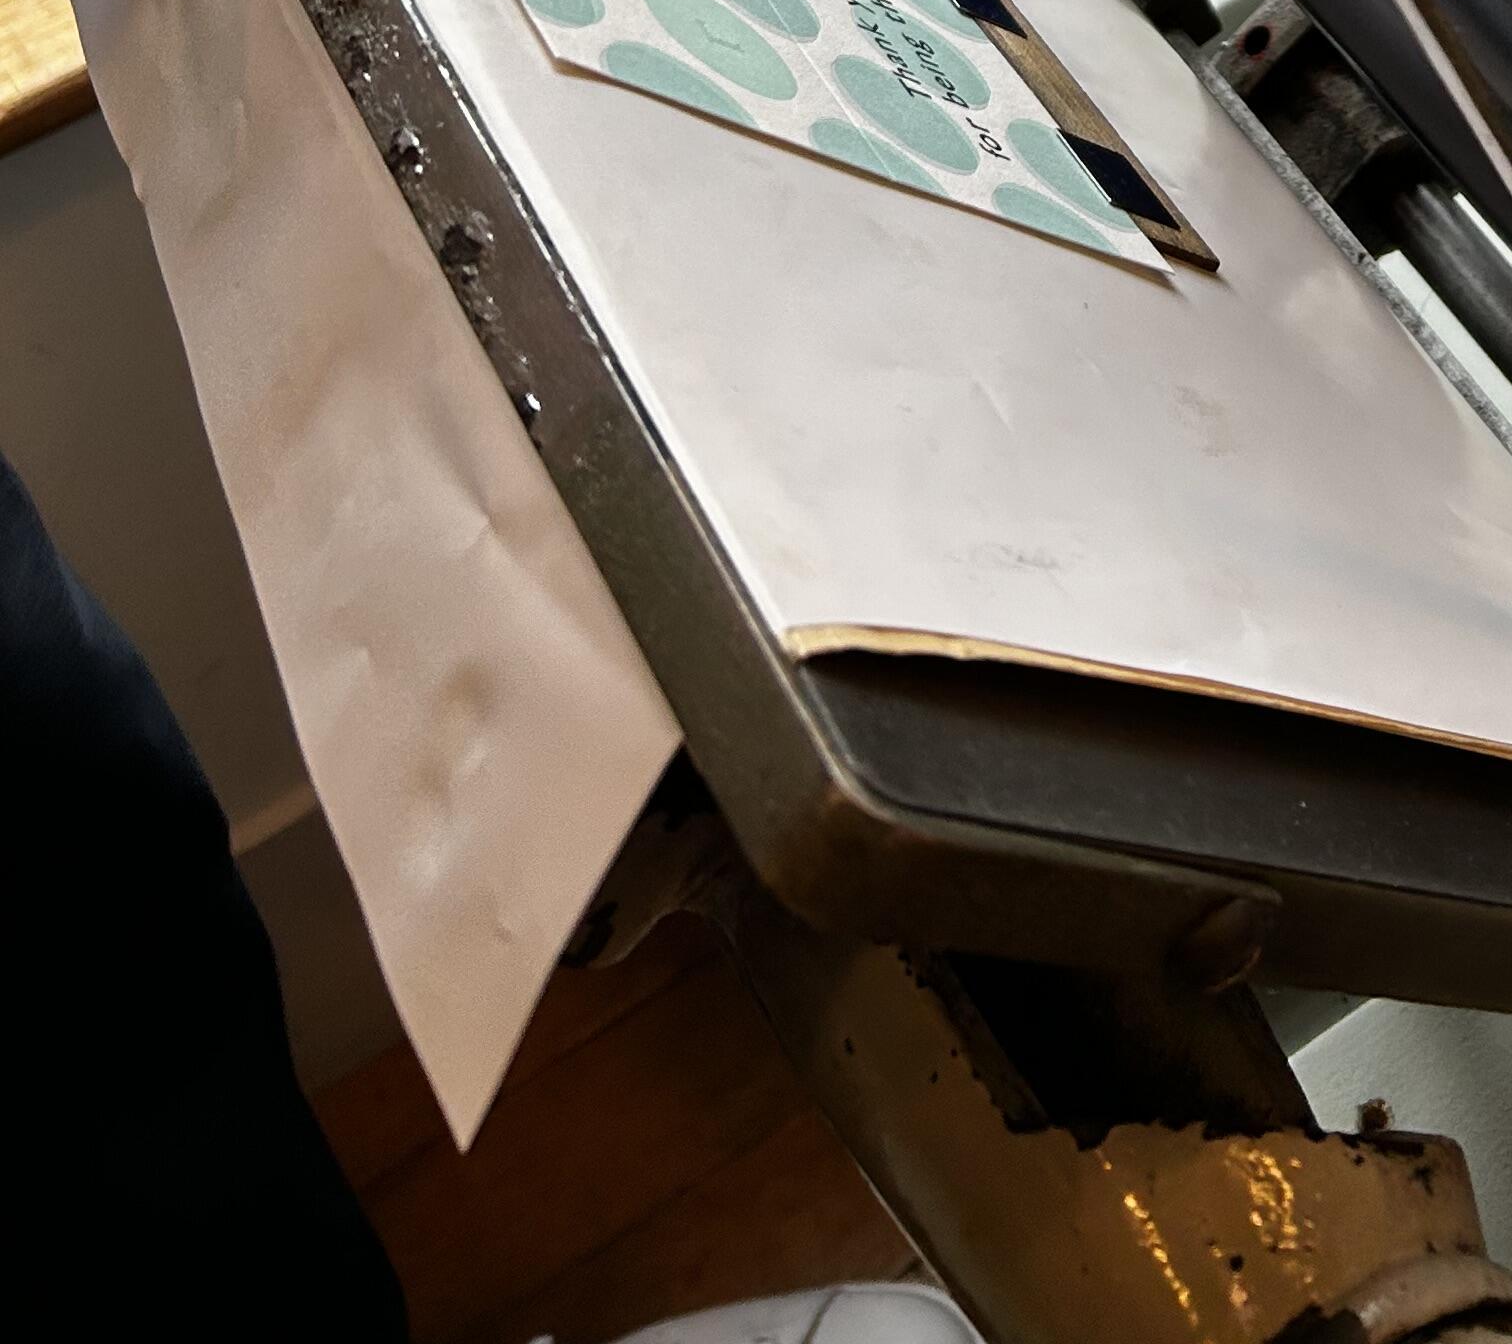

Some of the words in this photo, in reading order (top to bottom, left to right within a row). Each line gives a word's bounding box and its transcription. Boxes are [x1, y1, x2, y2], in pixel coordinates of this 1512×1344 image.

[857, 17, 932, 100] Thank
[902, 33, 970, 109] being
[965, 116, 1011, 161] for
